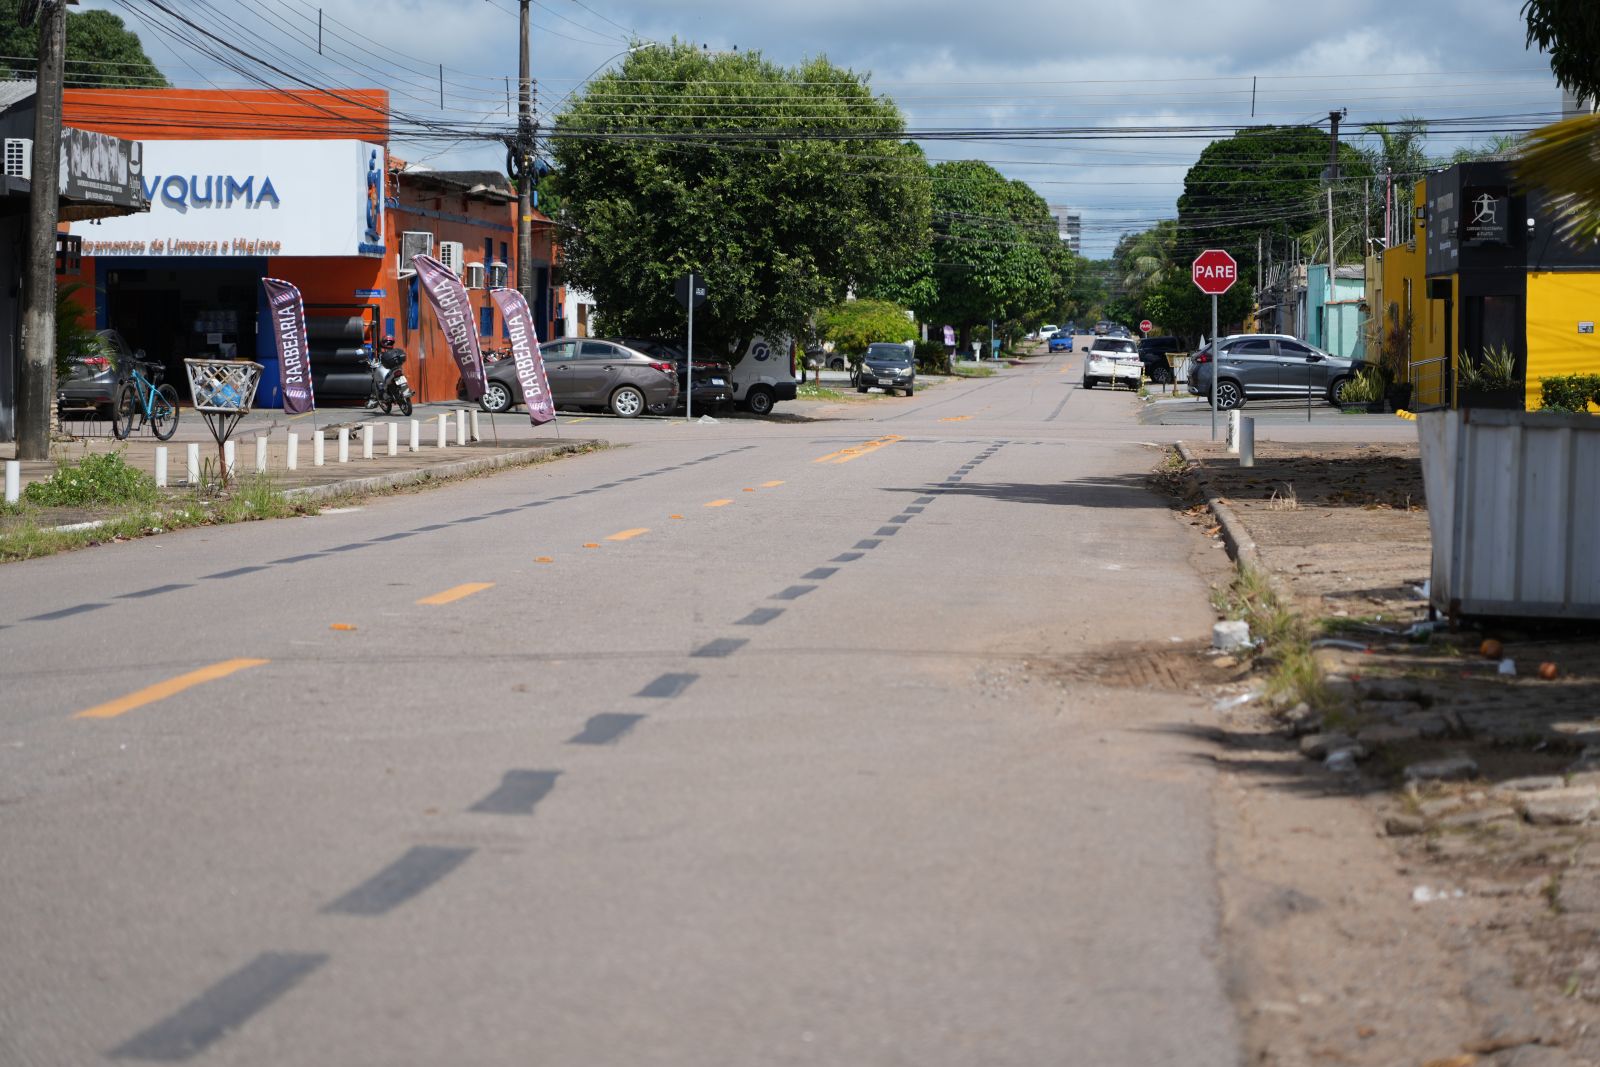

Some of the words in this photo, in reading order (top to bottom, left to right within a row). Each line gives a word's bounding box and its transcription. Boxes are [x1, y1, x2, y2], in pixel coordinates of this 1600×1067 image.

[81, 238, 146, 254] ipamentos
[151, 238, 164, 252] de
[167, 237, 218, 253] Limpeza
[232, 237, 281, 253] Higiene
[1195, 265, 1234, 278] PARE
[278, 304, 303, 384] BARBEARIA
[433, 278, 474, 366] BARBEARIA
[508, 314, 541, 398] BARBEARIA
